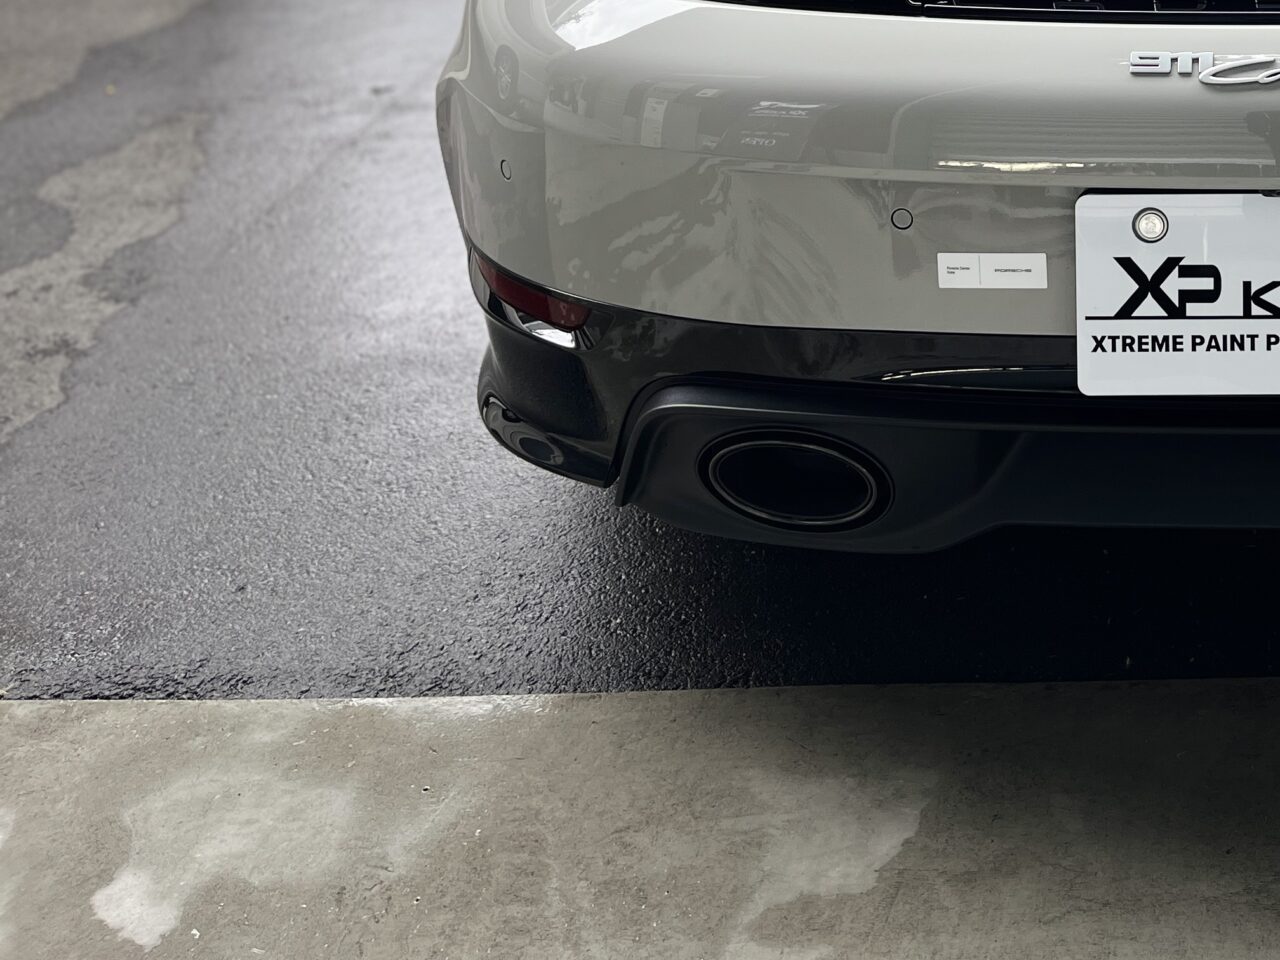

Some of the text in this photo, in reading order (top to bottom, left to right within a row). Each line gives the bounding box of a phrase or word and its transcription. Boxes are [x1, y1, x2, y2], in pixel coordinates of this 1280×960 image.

[1129, 51, 1215, 76] 911
[1091, 335, 1184, 353] XTREME
[1191, 334, 1260, 352] PAINT
